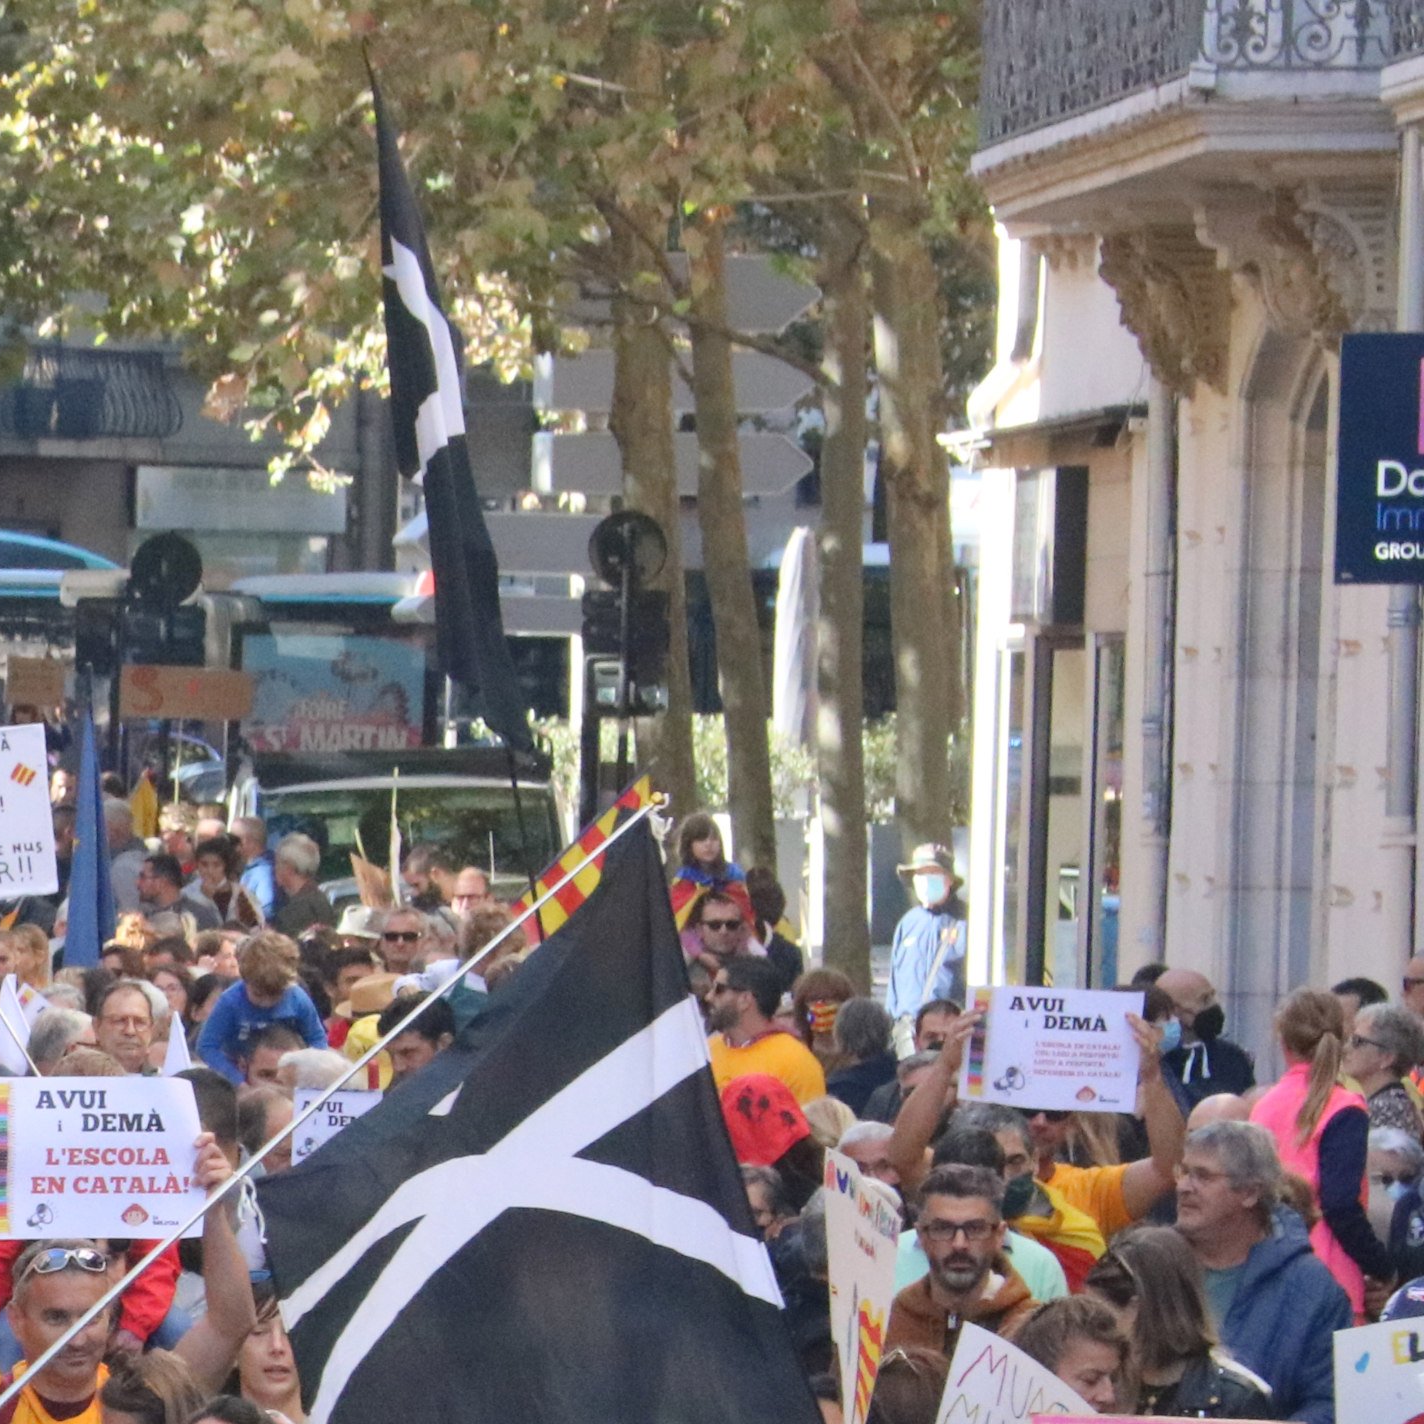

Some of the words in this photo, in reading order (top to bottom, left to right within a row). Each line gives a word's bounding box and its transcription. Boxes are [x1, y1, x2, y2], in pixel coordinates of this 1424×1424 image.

[300, 723, 410, 751] MARTIN
[1009, 996, 1065, 1013] AVUI
[1043, 1014, 1108, 1032] DEMÀ
[35, 1090, 107, 1110] AVUI
[57, 1120, 63, 1132] i
[81, 1108, 166, 1132] DEMÀ
[45, 1148, 171, 1166] L'ESCOLA
[31, 1176, 66, 1194] EN
[72, 1172, 191, 1195] CATALÀ!
